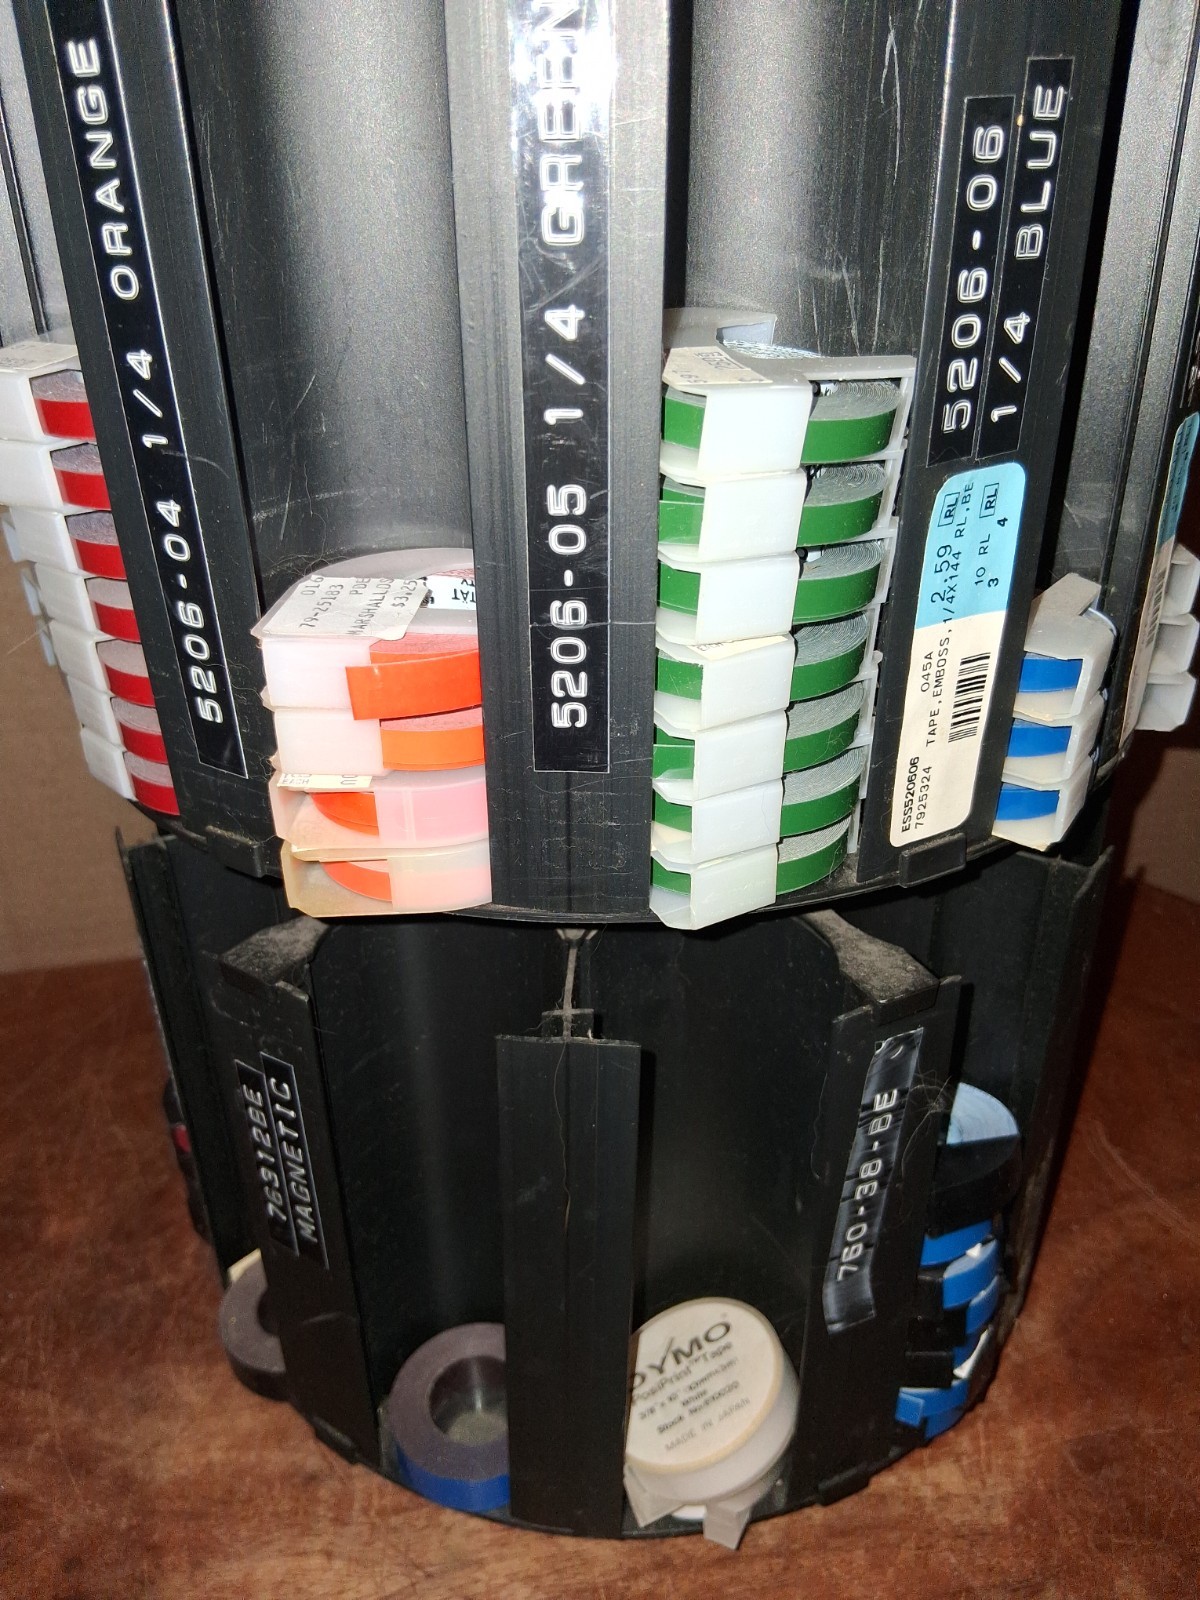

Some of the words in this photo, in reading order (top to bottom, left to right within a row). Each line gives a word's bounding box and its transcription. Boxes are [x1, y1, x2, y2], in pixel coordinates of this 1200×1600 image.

[67, 38, 140, 300] ORANGE
[534, 0, 585, 246] GREEN
[943, 125, 1004, 434] 5206-06
[991, 312, 1031, 423] 1/4
[1015, 85, 1064, 260] BLUE
[126, 349, 169, 448] 1/4
[543, 304, 586, 425] 1/4
[930, 544, 952, 603] 2.59
[944, 497, 958, 519] RL
[978, 533, 991, 555] RL
[984, 488, 998, 510] RL
[391, 580, 418, 608] $3.25
[975, 567, 986, 586] 10
[987, 577, 1000, 588] 3
[997, 517, 1008, 527] 4
[156, 500, 224, 724] 5206-04
[300, 584, 344, 627] 79-25183
[546, 484, 588, 729] 5206-05
[901, 756, 920, 833] ESS520606
[915, 766, 932, 829] 7925324
[269, 1077, 318, 1243] MAGNETIC
[837, 1088, 898, 1282] 760-38-BE
[664, 1429, 697, 1450] MADE
